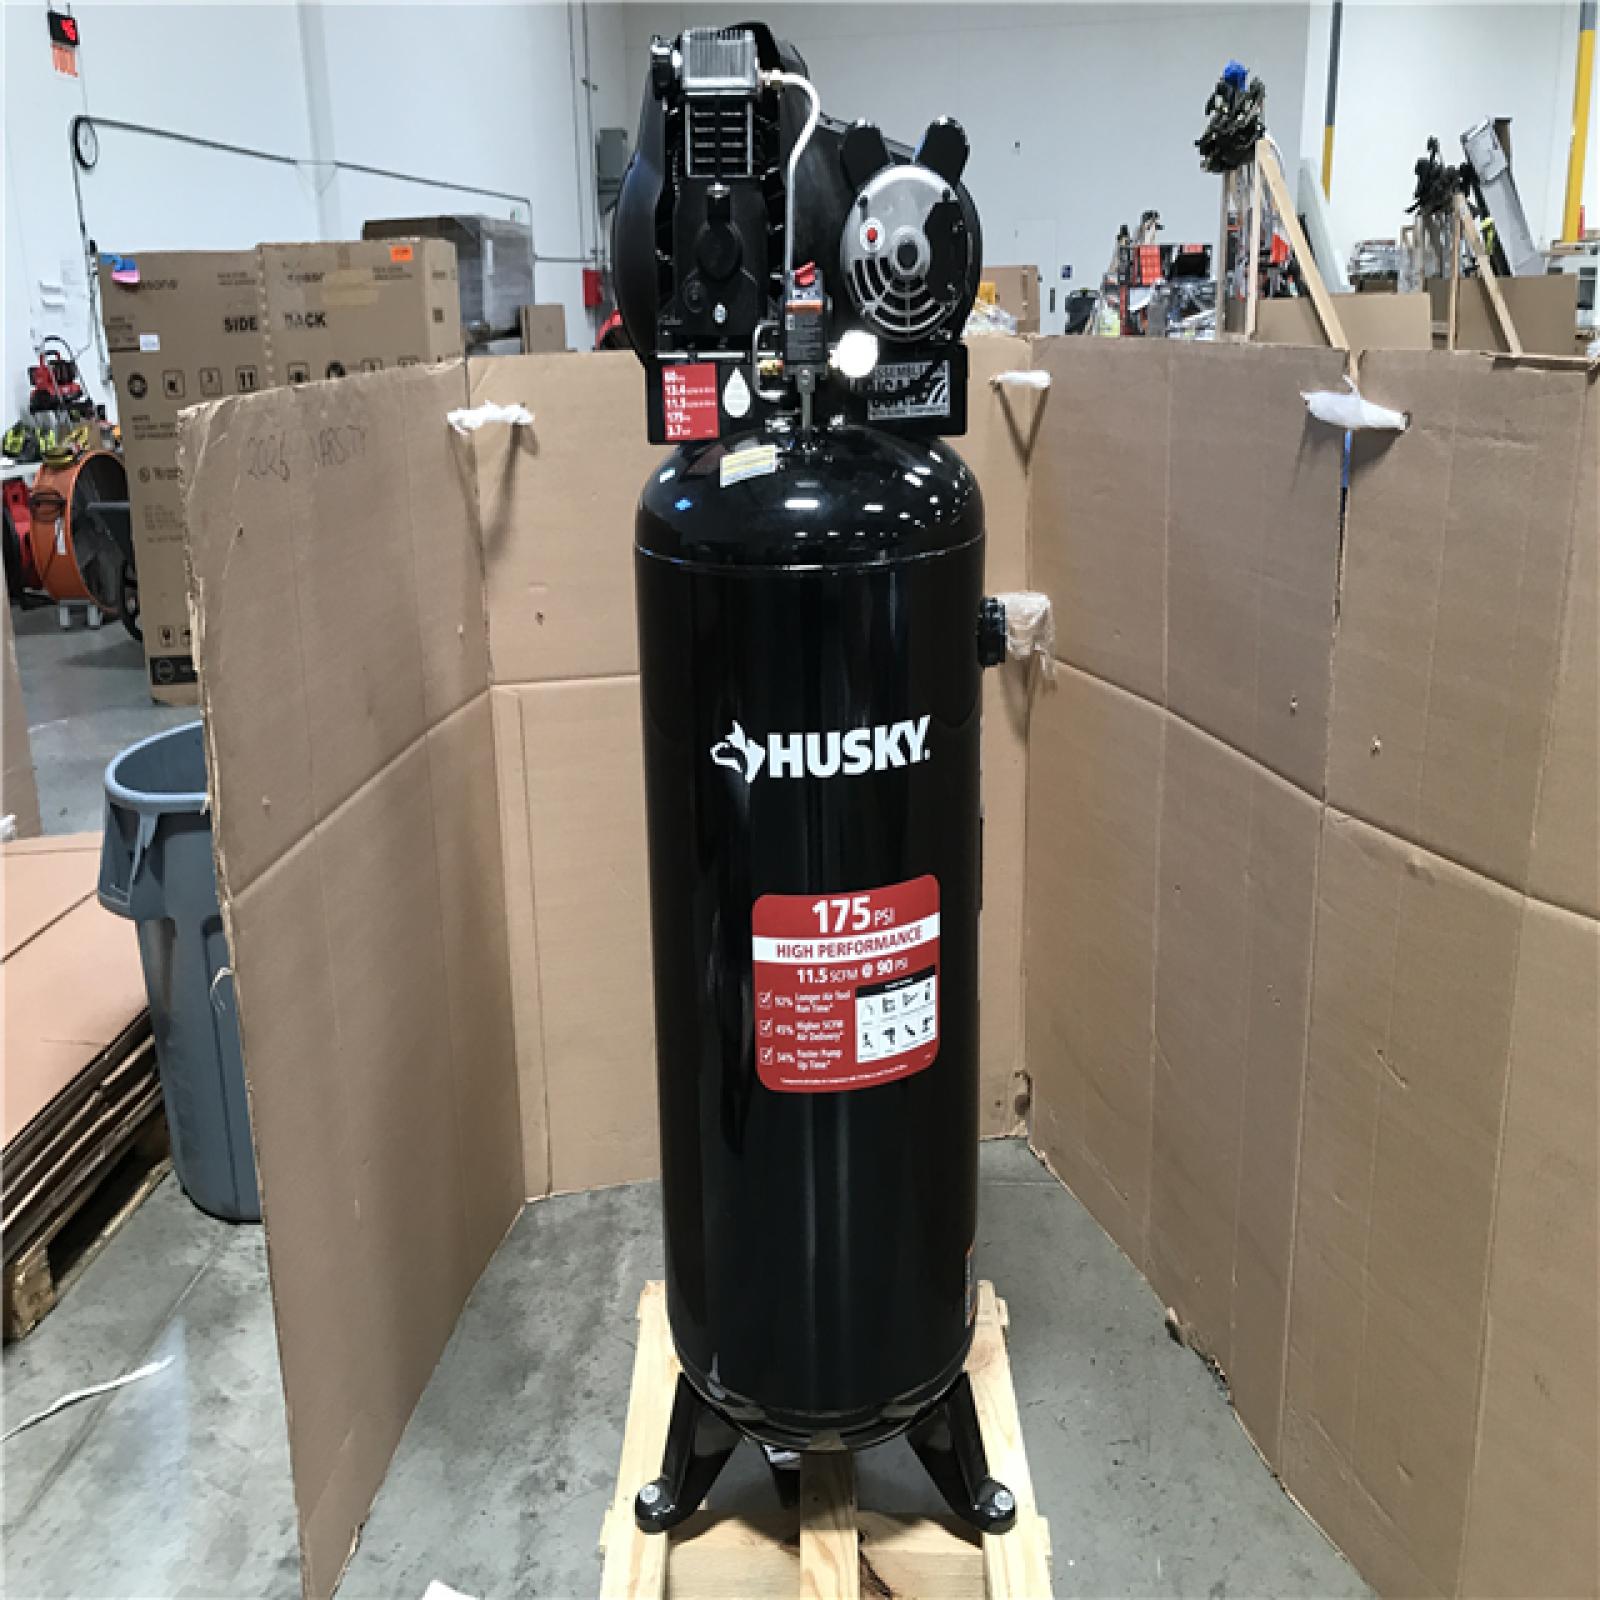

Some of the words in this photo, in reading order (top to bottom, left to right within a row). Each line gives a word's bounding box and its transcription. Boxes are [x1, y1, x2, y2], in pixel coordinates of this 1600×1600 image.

[224, 315, 258, 333] SIDE
[766, 714, 931, 779] HUSKY
[812, 894, 872, 934] 175
[874, 907, 896, 927] PSI
[776, 943, 814, 959] HIGH
[817, 924, 923, 958] PERFORMANCE
[797, 967, 829, 984] 11.5
[876, 958, 894, 976] 90
